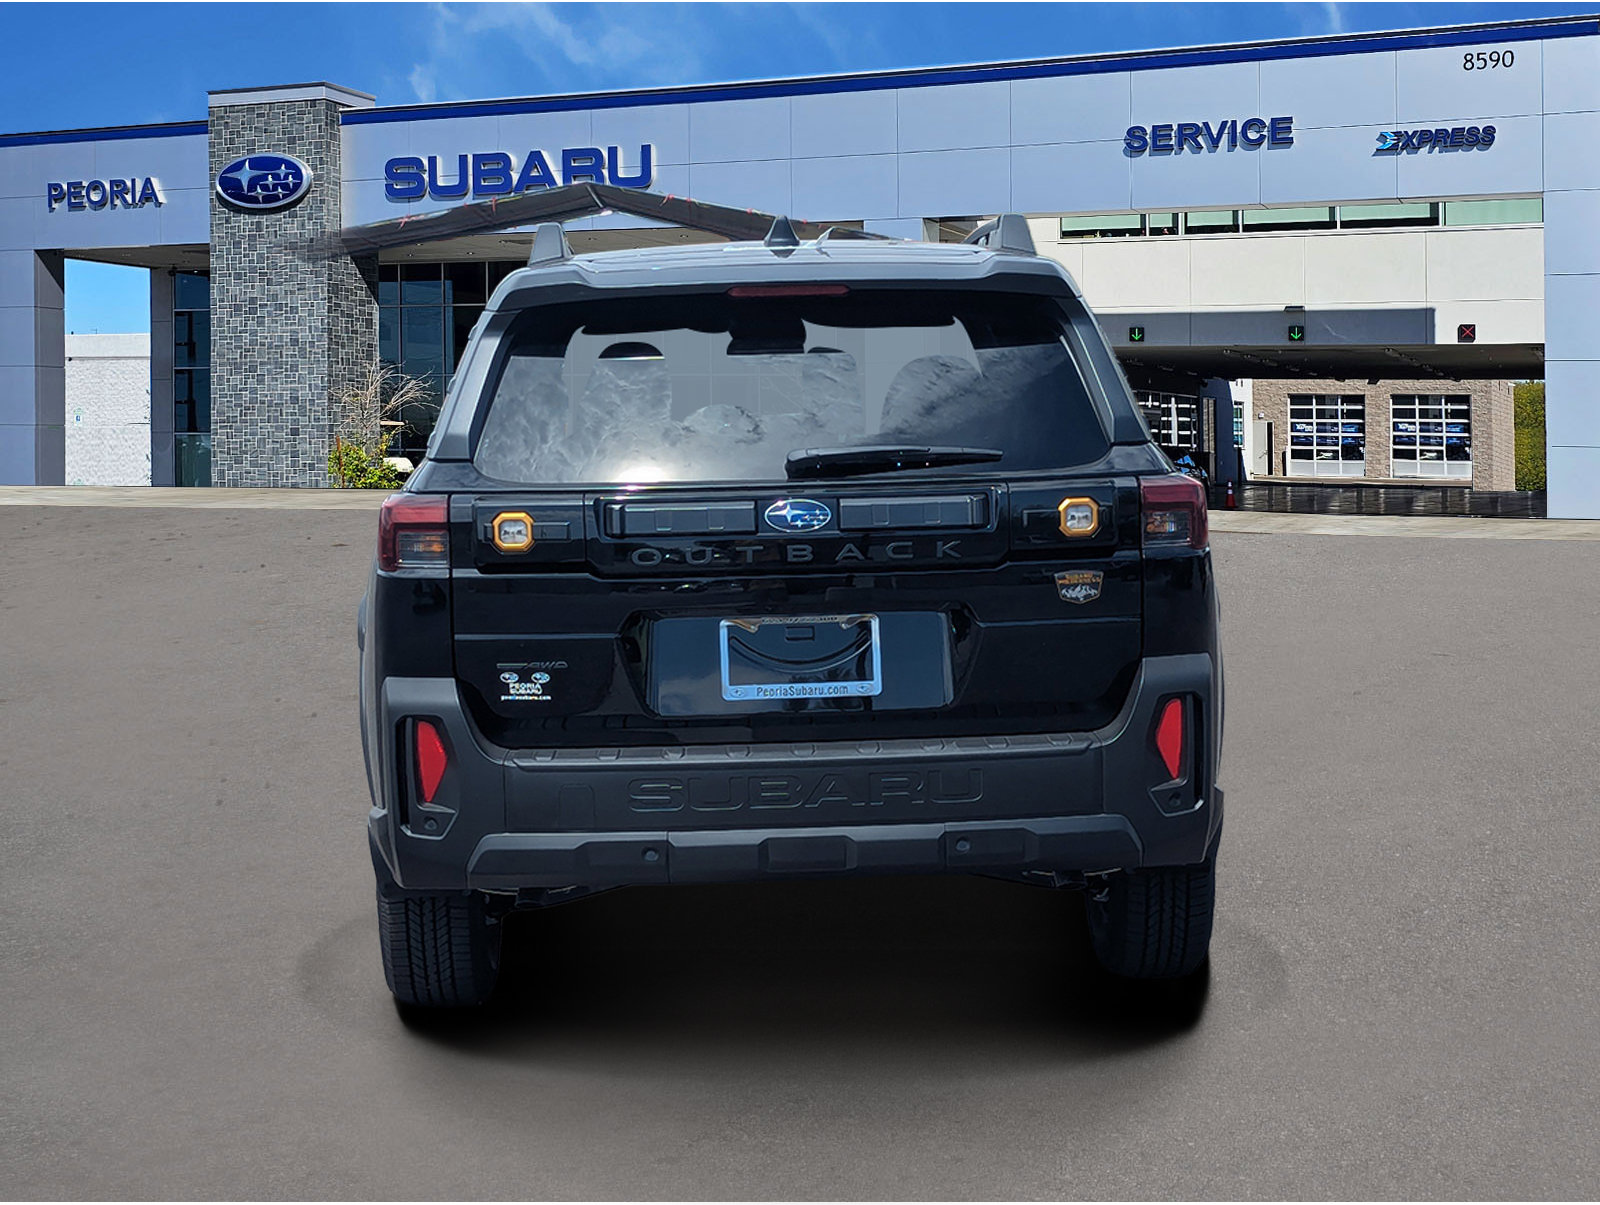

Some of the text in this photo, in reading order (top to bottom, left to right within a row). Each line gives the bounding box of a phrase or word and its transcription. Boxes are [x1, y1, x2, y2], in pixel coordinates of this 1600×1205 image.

[1463, 50, 1515, 71] 8590
[1124, 116, 1294, 155] SERVICE
[1375, 125, 1497, 155] EXPRESS
[384, 143, 654, 203] SUBARU
[47, 177, 162, 212] PEORIA
[631, 540, 962, 567] OUTBACK
[524, 661, 568, 669] AWD
[756, 685, 849, 697] PeoriaSubaru.com
[629, 769, 985, 812] SUBARU
